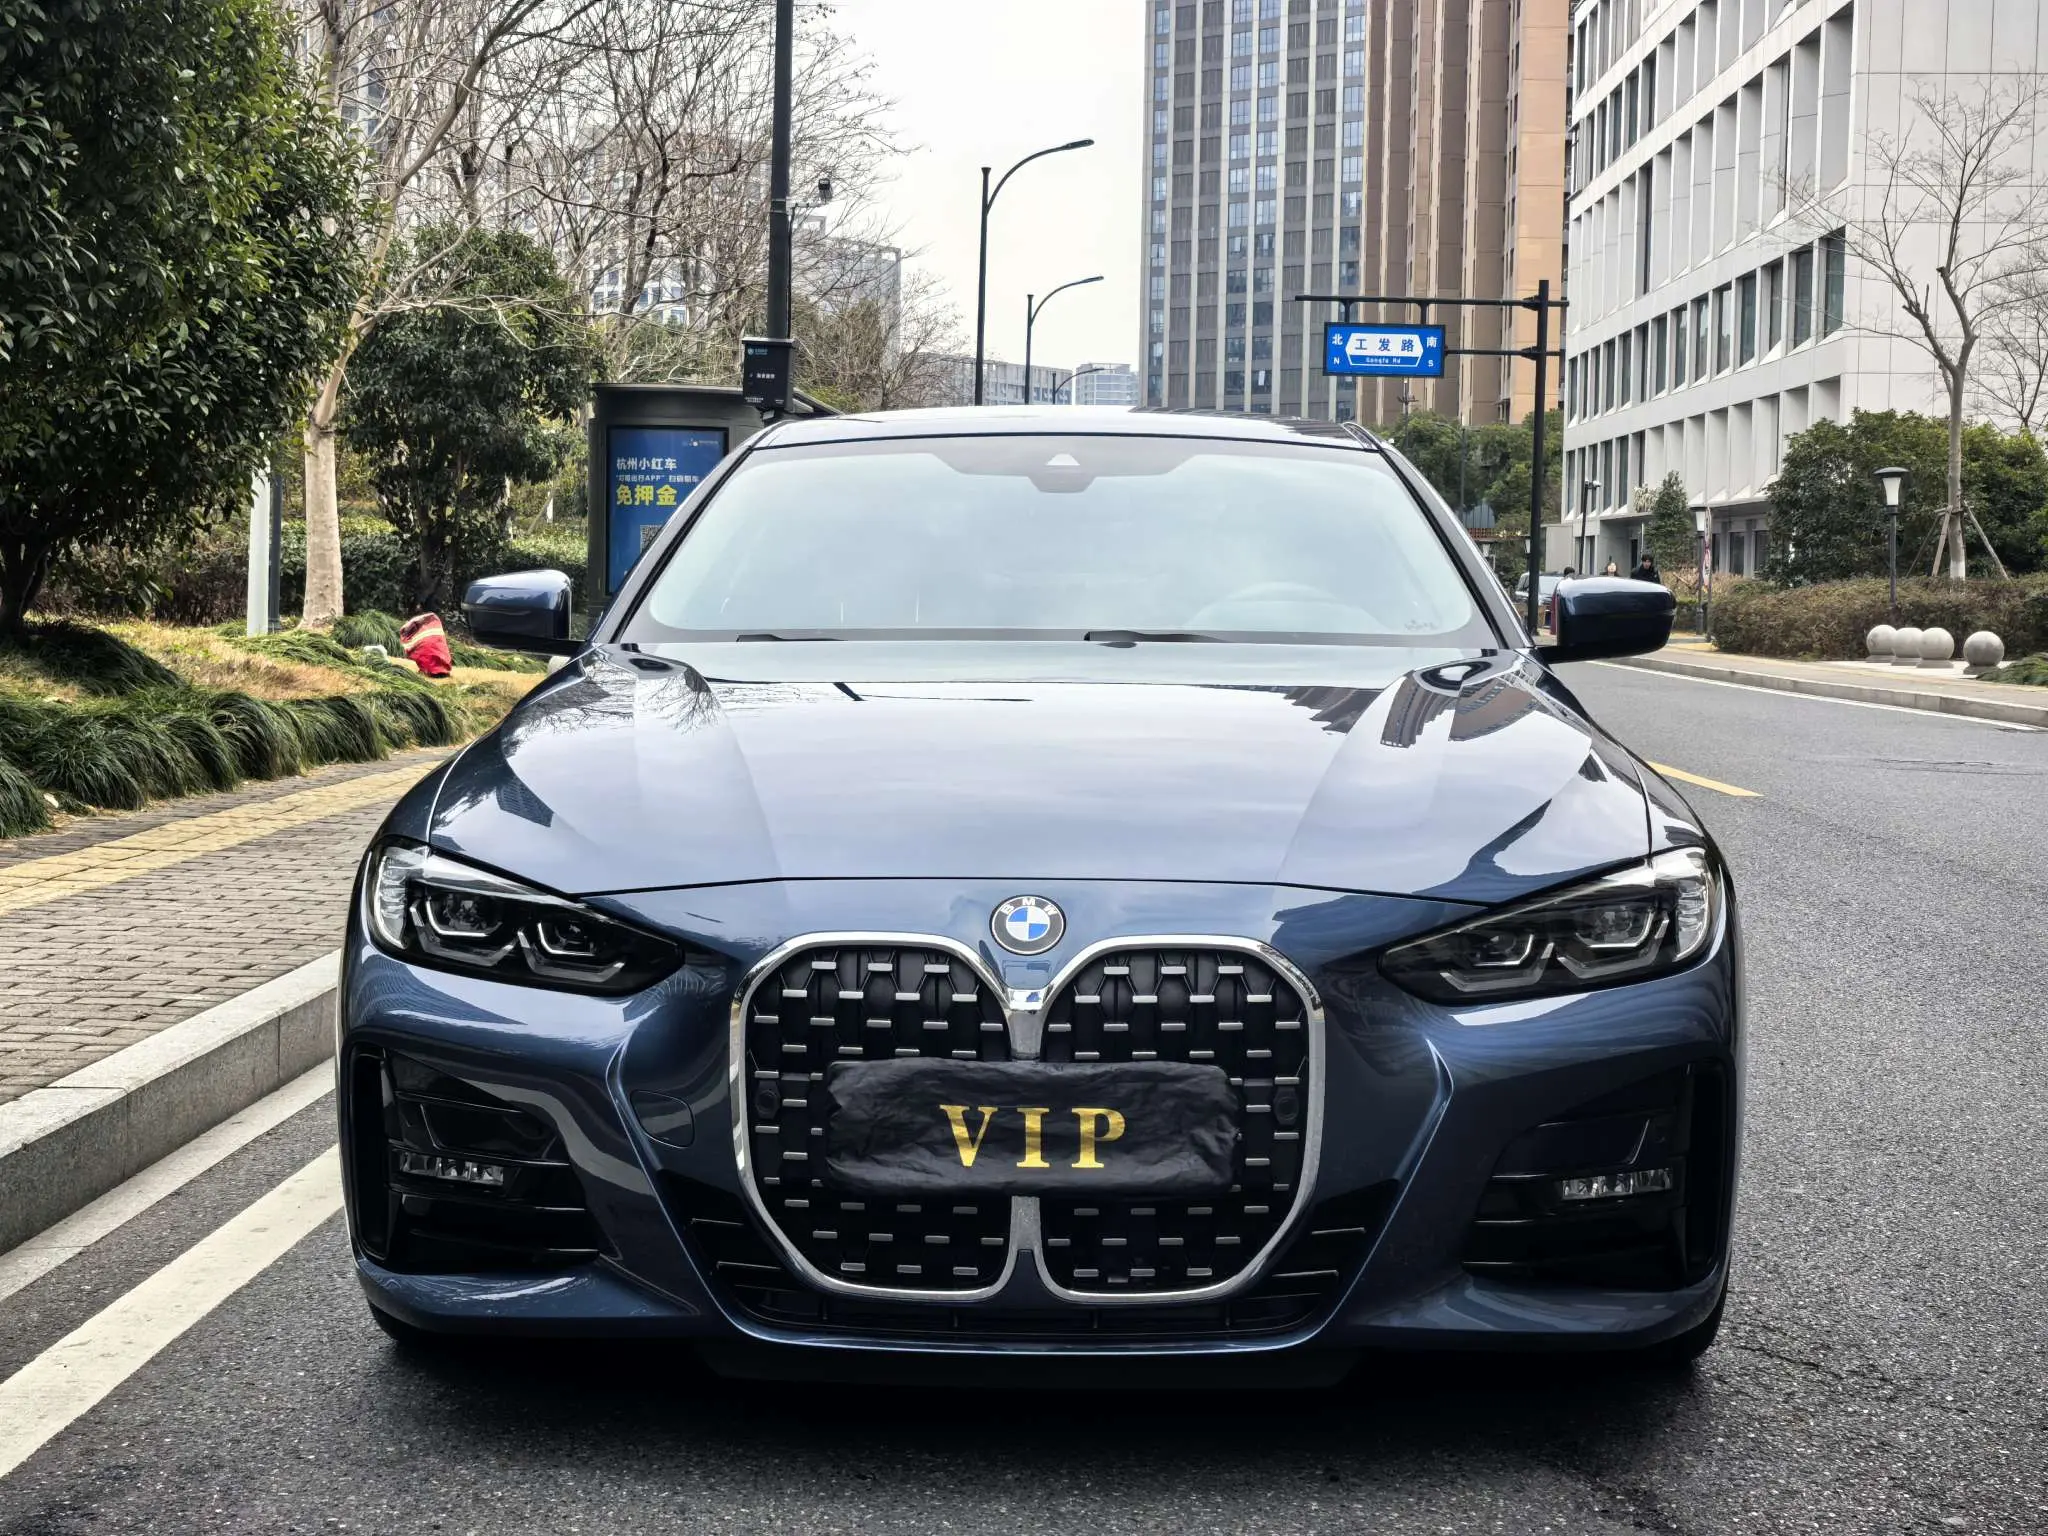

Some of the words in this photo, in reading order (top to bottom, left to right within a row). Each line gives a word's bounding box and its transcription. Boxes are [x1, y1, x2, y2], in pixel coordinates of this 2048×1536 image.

[1332, 333, 1343, 345] 北
[1355, 338, 1414, 352] 工发路
[1426, 336, 1438, 348] 南
[1333, 357, 1340, 365] N
[616, 457, 677, 470] 杭州小红车
[616, 484, 677, 505] 免押金
[1000, 897, 1058, 916] BMW
[939, 1104, 1126, 1168] VIP
